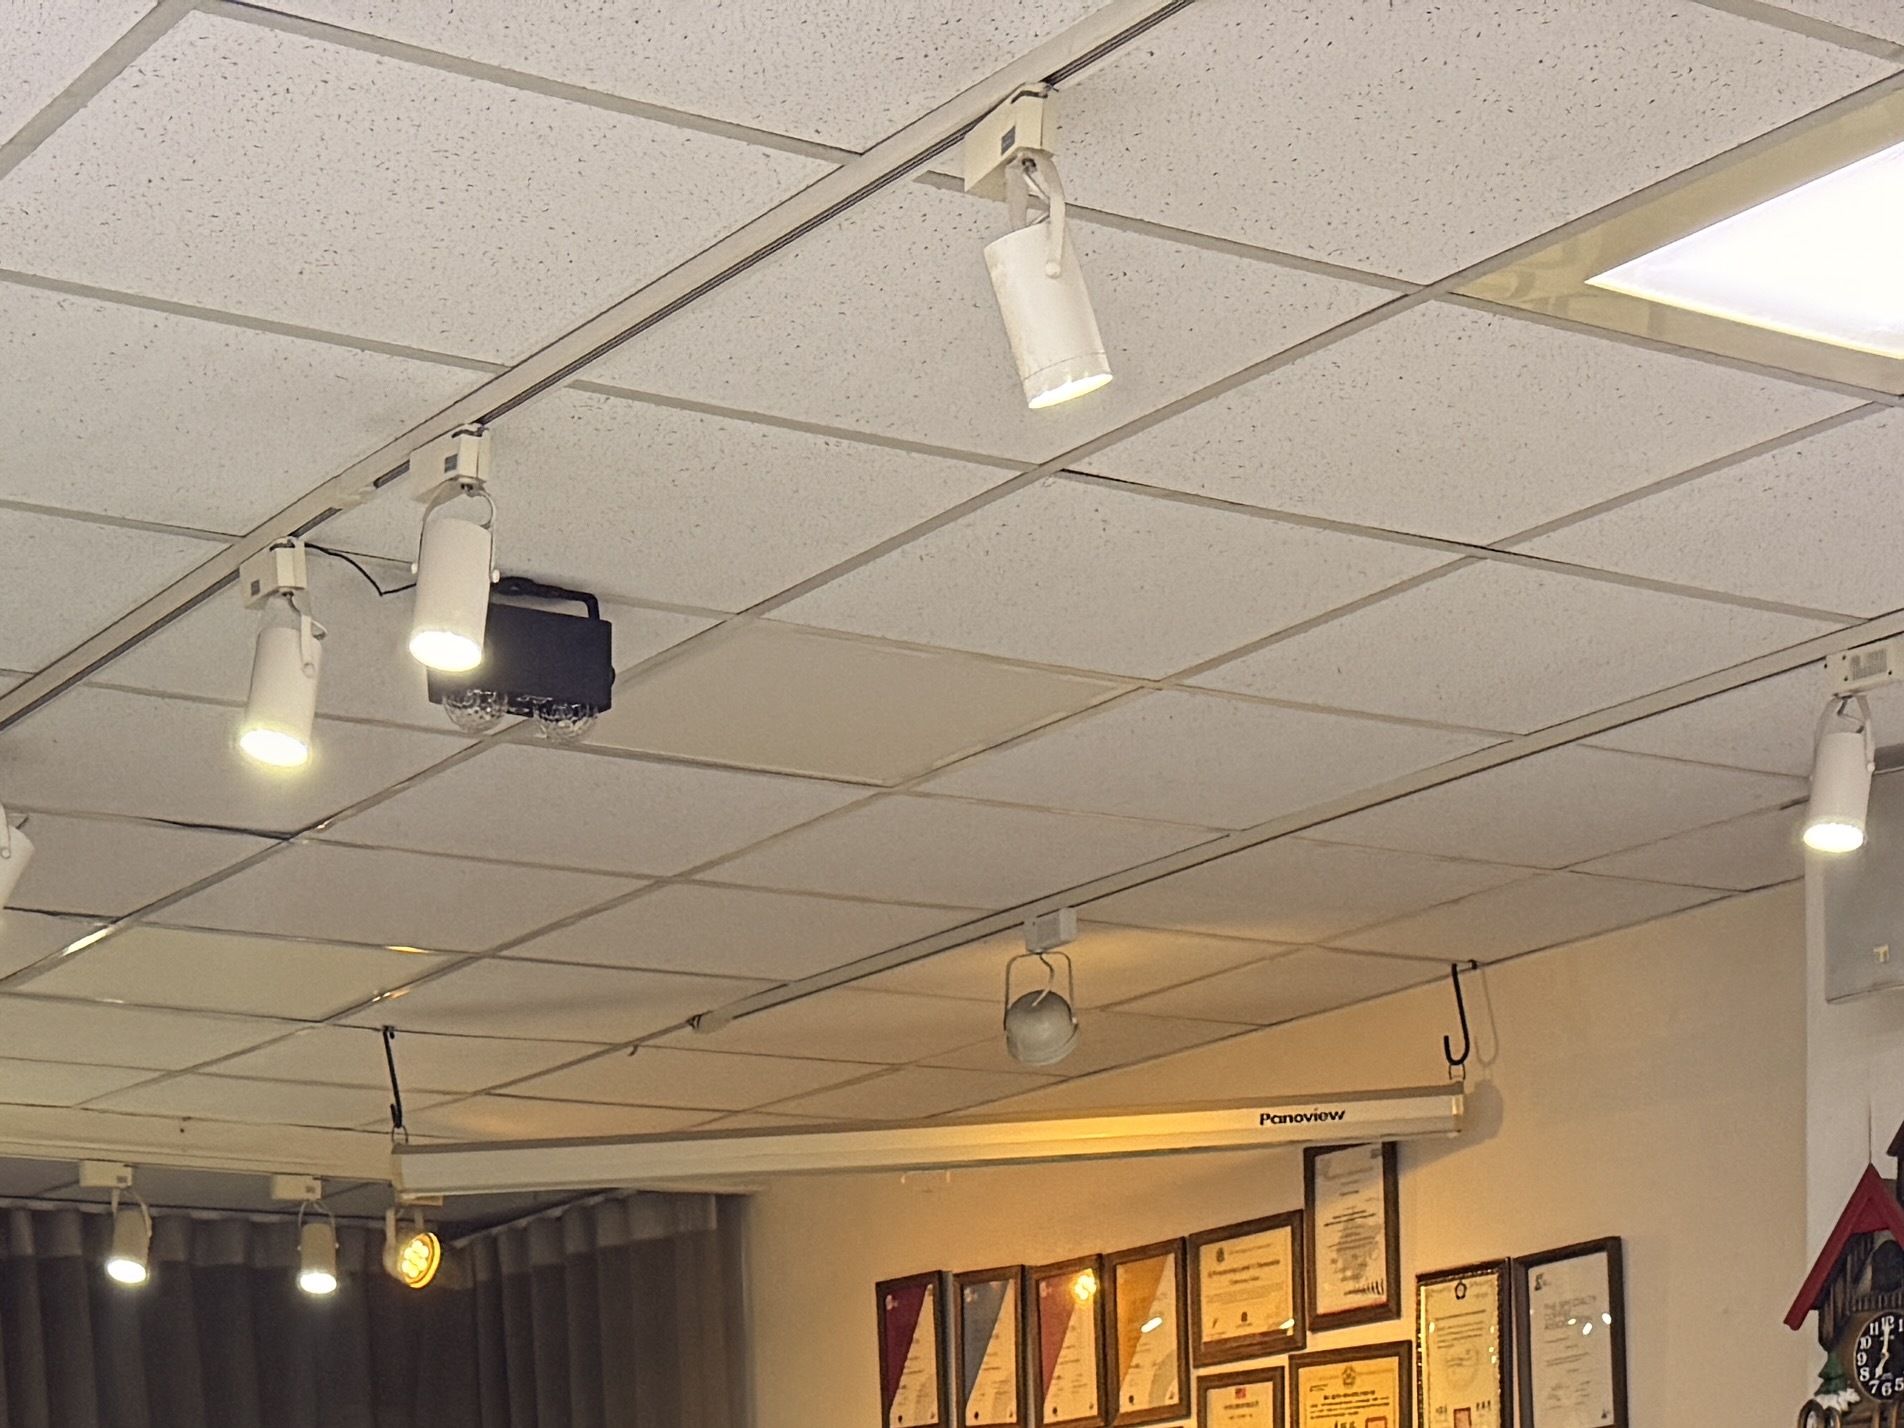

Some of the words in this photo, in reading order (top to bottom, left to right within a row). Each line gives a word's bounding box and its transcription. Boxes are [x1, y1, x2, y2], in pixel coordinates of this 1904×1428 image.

[1260, 1108, 1346, 1125] Panoview
[1869, 1321, 1879, 1336] 11
[1898, 1318, 1903, 1332] 1
[1860, 1335, 1872, 1350] 10
[1857, 1351, 1867, 1366] 9
[1859, 1366, 1870, 1382] 8
[1868, 1380, 1880, 1394] 7
[1881, 1381, 1892, 1396] 6
[1894, 1377, 1904, 1391] 5
